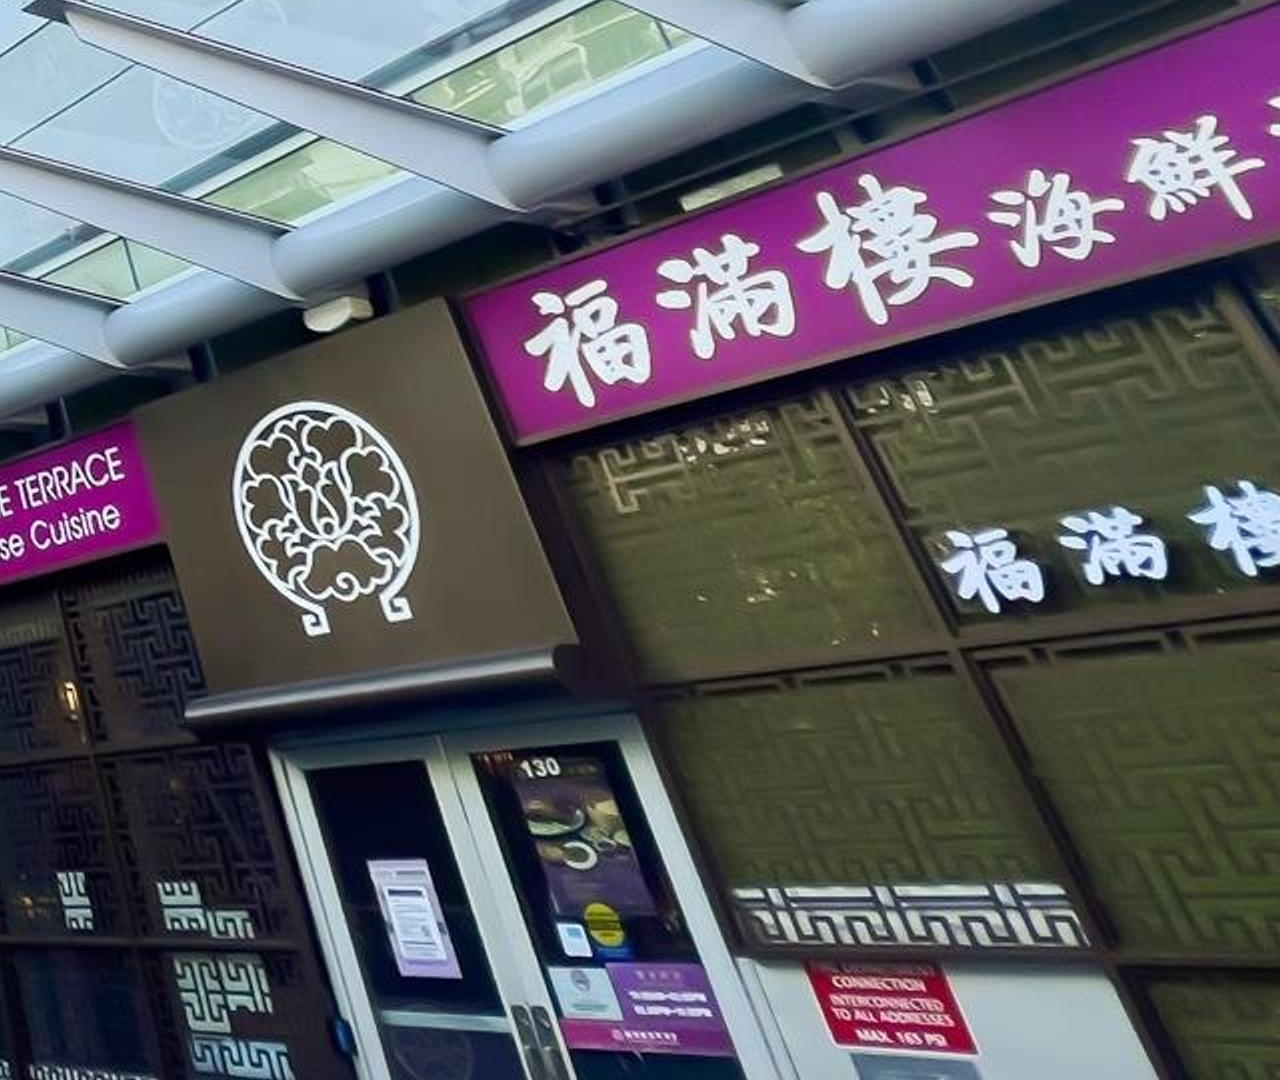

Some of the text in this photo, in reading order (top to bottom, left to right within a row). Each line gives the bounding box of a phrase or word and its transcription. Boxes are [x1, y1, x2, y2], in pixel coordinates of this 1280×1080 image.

[525, 96, 1280, 407] 福滿樓海鮮
[14, 446, 125, 510] TERRACE
[30, 504, 121, 550] Cuisine
[520, 757, 561, 778] 130
[831, 975, 927, 993] CONNECTION
[829, 993, 945, 1012] INTERCONNECTED
[831, 1007, 955, 1028] TO ALL ADDRESSES
